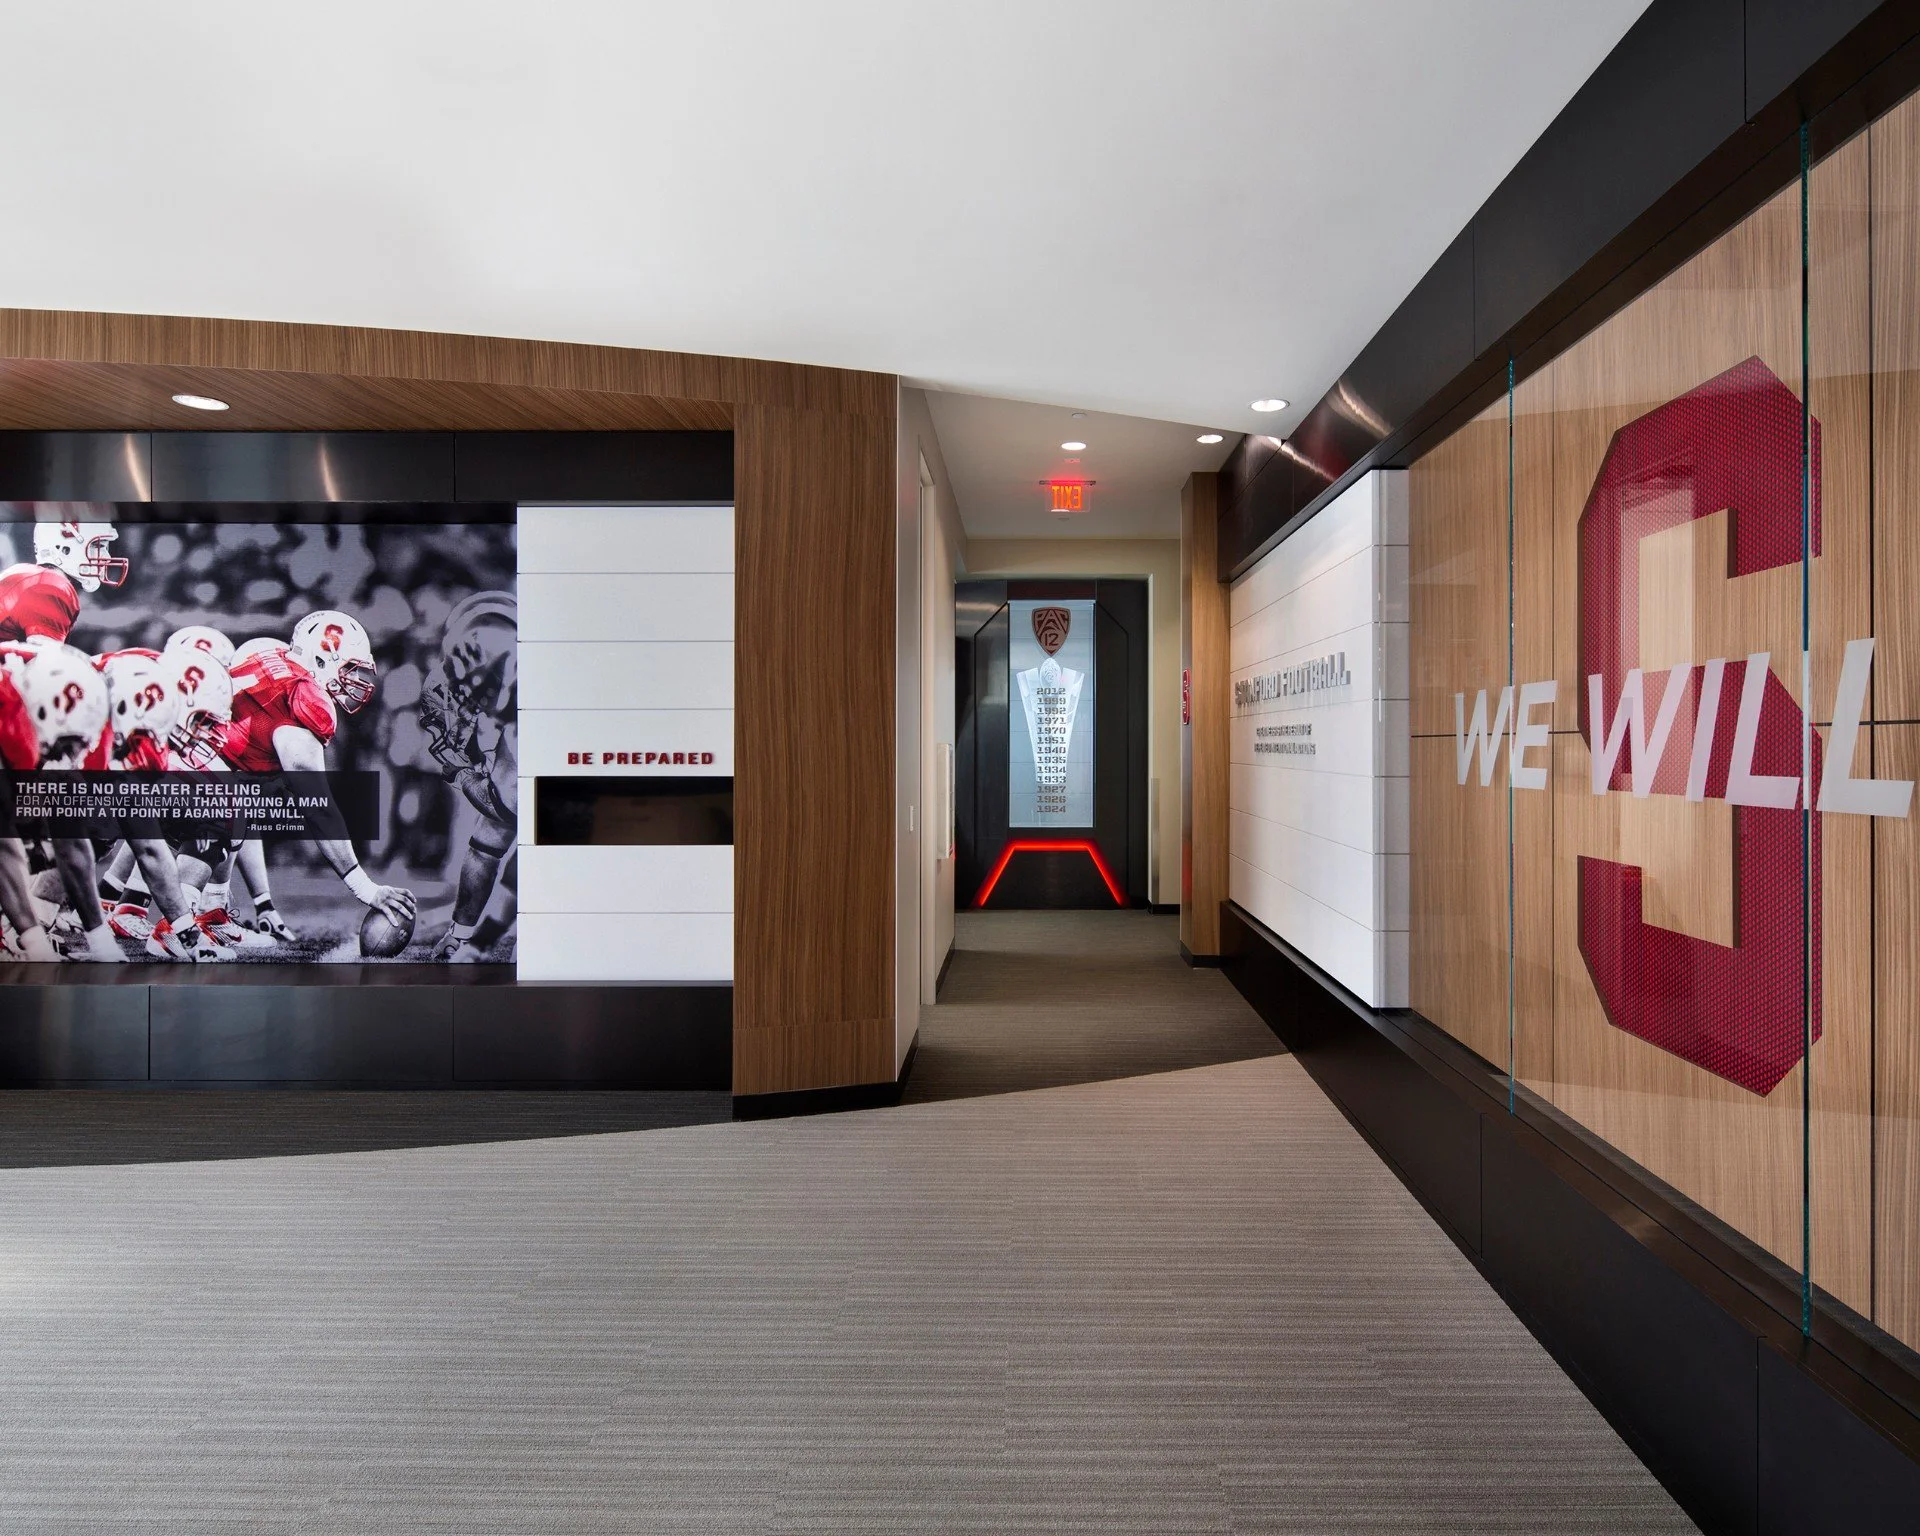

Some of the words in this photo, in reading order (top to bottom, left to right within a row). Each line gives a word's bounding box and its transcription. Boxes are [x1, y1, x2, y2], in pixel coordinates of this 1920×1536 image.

[1044, 633, 1059, 646] 12
[1283, 652, 1351, 697] FOOTBALL
[1455, 680, 1558, 790] WE
[1588, 637, 1915, 818] WILL
[568, 752, 594, 765] BE
[603, 752, 714, 765] PREPARED
[16, 782, 67, 794] THERE
[73, 782, 87, 794] IS
[93, 783, 114, 795] NO
[119, 783, 191, 795] GREATER
[196, 784, 261, 796] FEELING
[16, 795, 40, 806] FOR
[43, 795, 60, 806] AN
[63, 795, 131, 806] OFFENSIVE
[134, 796, 189, 807] LINEMAN
[193, 797, 228, 807] THAN
[232, 797, 283, 807] MOVING
[287, 797, 295, 807] A
[299, 797, 328, 807] MAN
[16, 807, 52, 818] FROM
[56, 807, 94, 818] POINT
[98, 807, 107, 818] A
[110, 807, 126, 818] TO
[130, 807, 169, 818] POINT
[173, 808, 181, 819] B
[184, 808, 240, 819] AGAINST
[244, 808, 266, 819] HIS
[269, 808, 305, 819] WILL.
[247, 823, 273, 832] -Russ
[275, 823, 305, 832] Grimm
